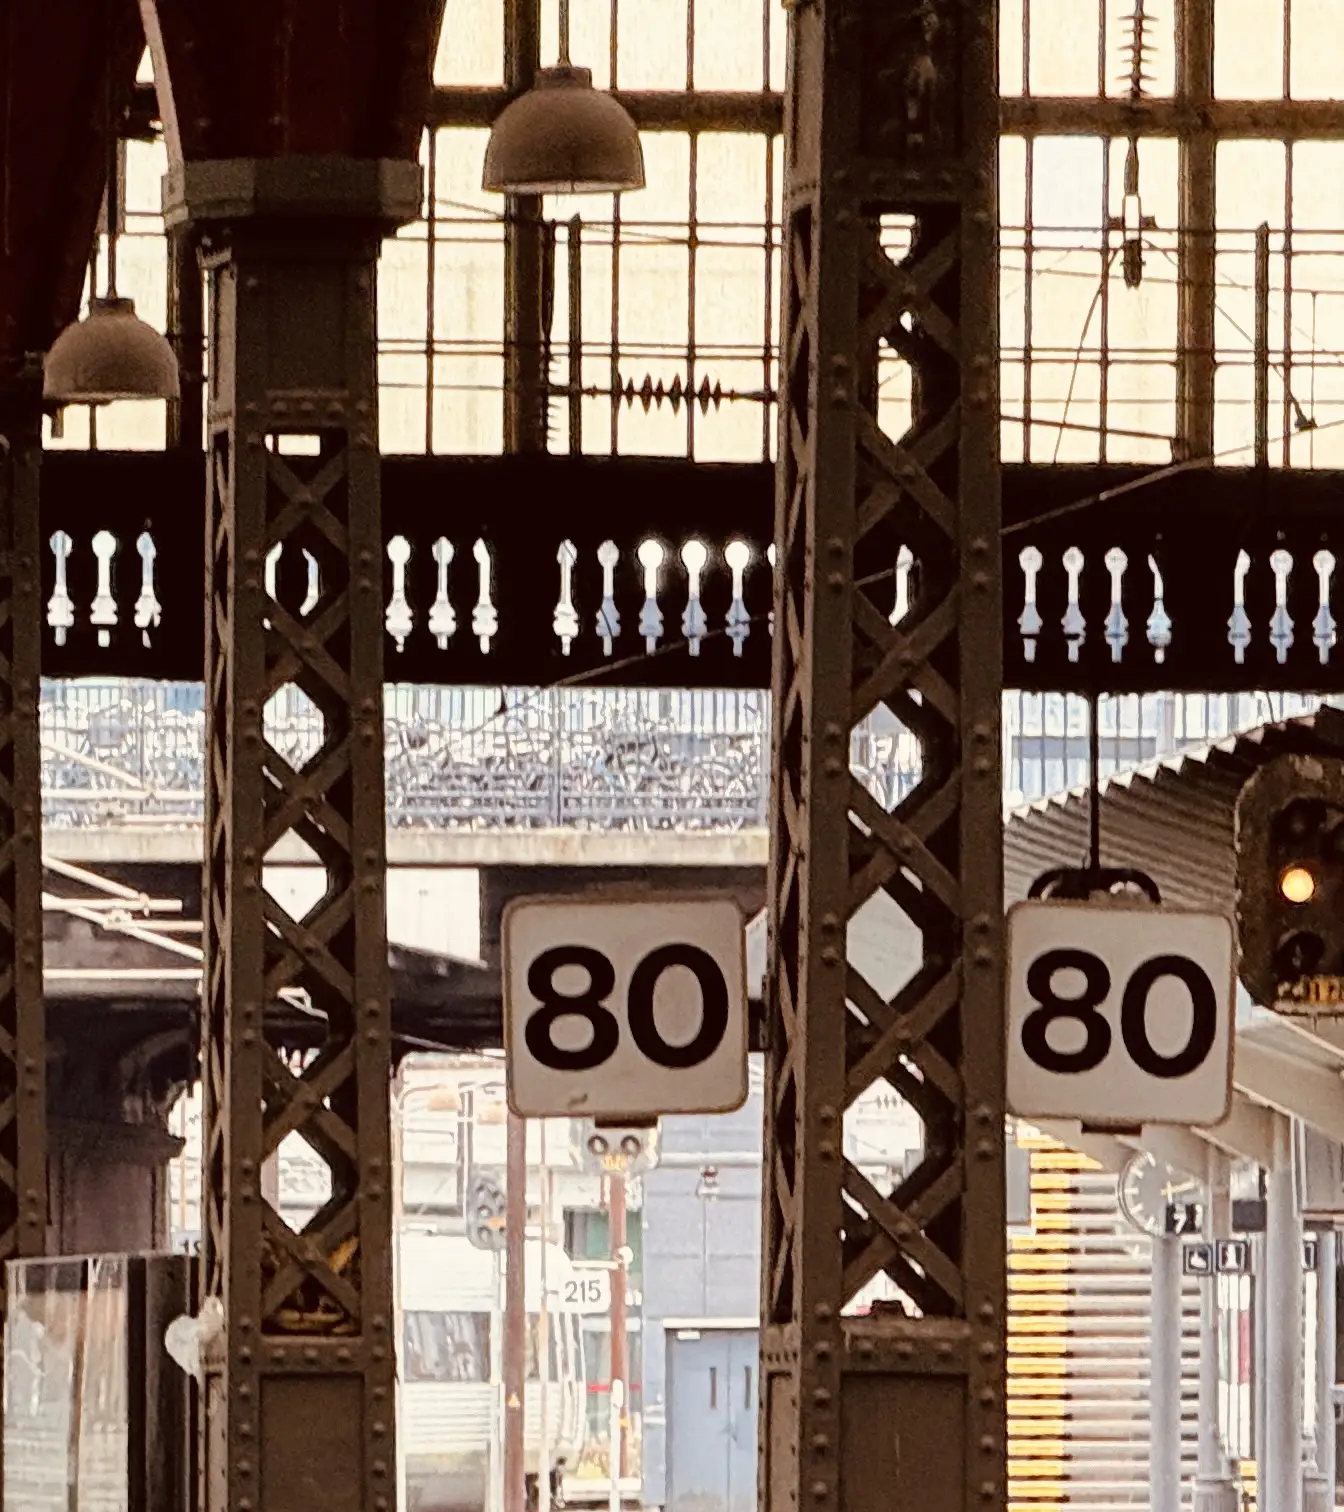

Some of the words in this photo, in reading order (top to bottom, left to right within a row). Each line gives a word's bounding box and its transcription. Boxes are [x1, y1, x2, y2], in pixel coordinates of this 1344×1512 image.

[524, 943, 729, 1071] 80
[1021, 948, 1217, 1079] 80
[564, 1279, 602, 1304] 215
